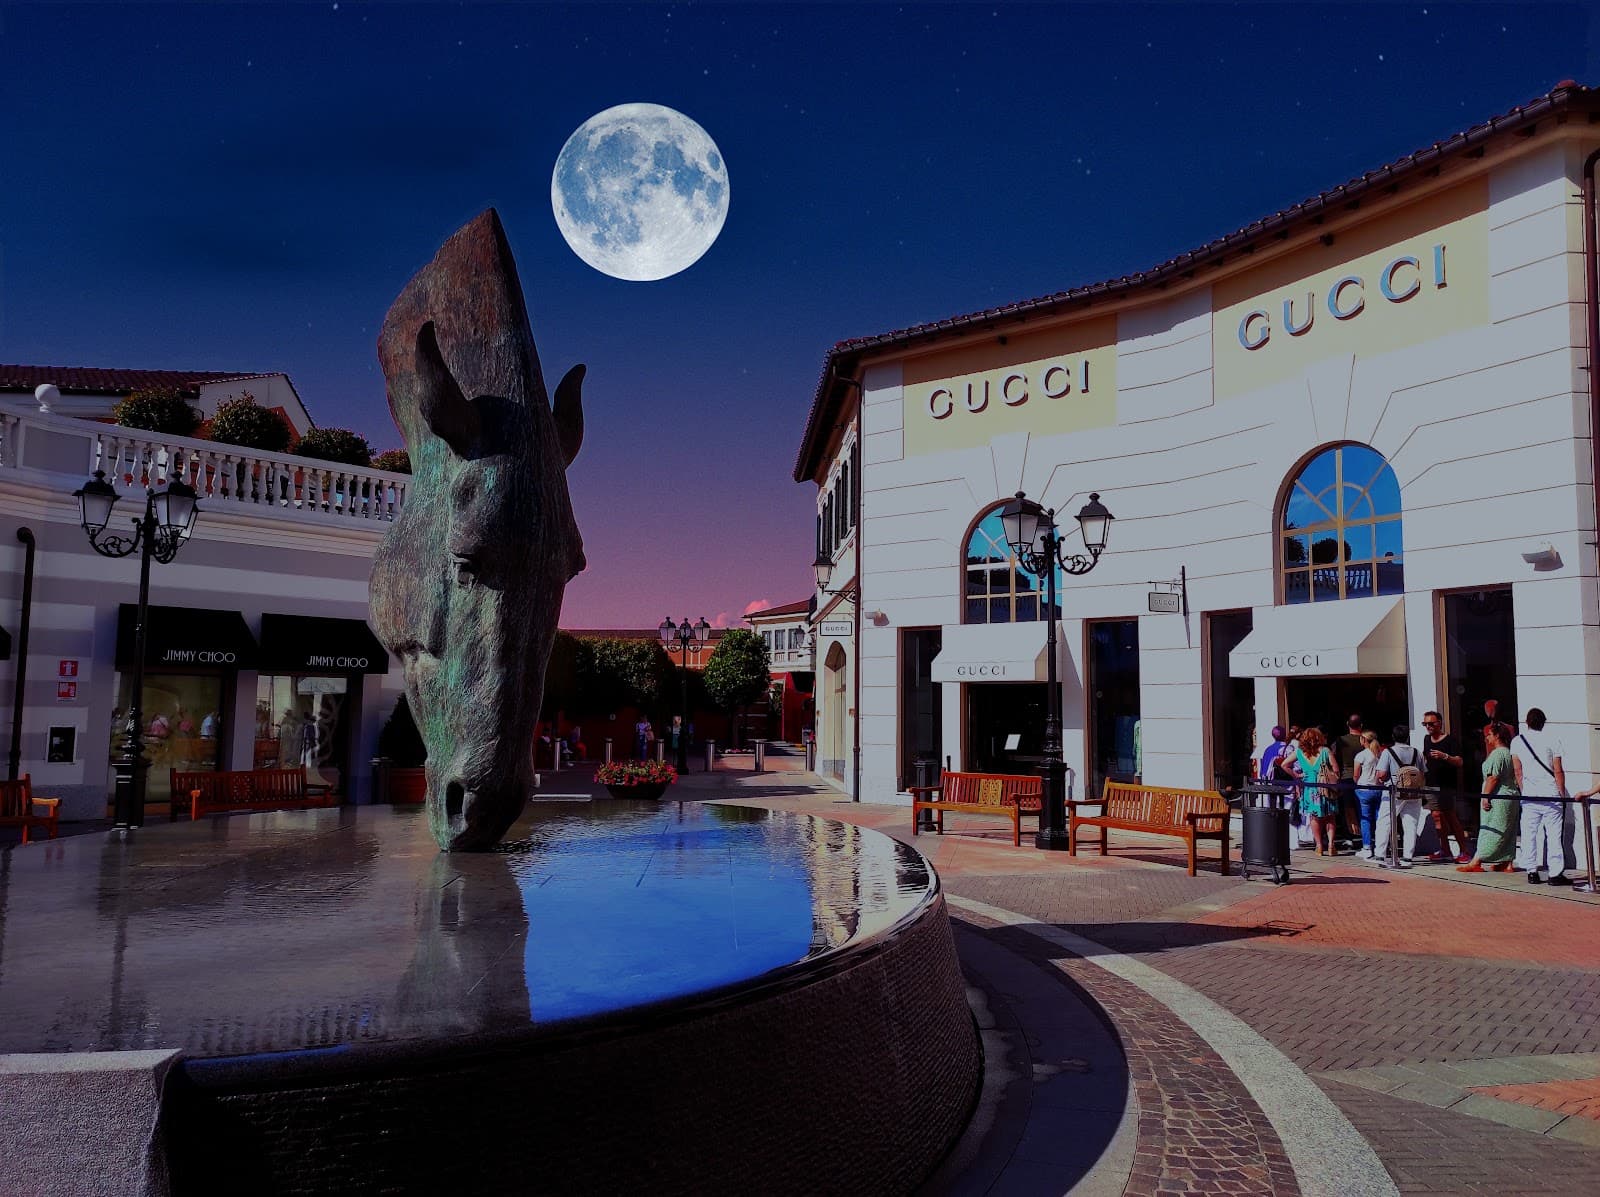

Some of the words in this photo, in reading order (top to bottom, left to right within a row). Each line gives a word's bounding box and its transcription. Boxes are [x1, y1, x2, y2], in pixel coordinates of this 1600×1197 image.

[1238, 243, 1447, 350] GUCCI
[929, 359, 1090, 419] GUCCI
[163, 650, 196, 662] JIMMY
[198, 651, 236, 663] CHOO
[306, 655, 336, 667] JIMMY
[336, 656, 369, 668] CHOO
[1260, 654, 1319, 668] GUCCI
[957, 665, 1006, 676] GUCCI
